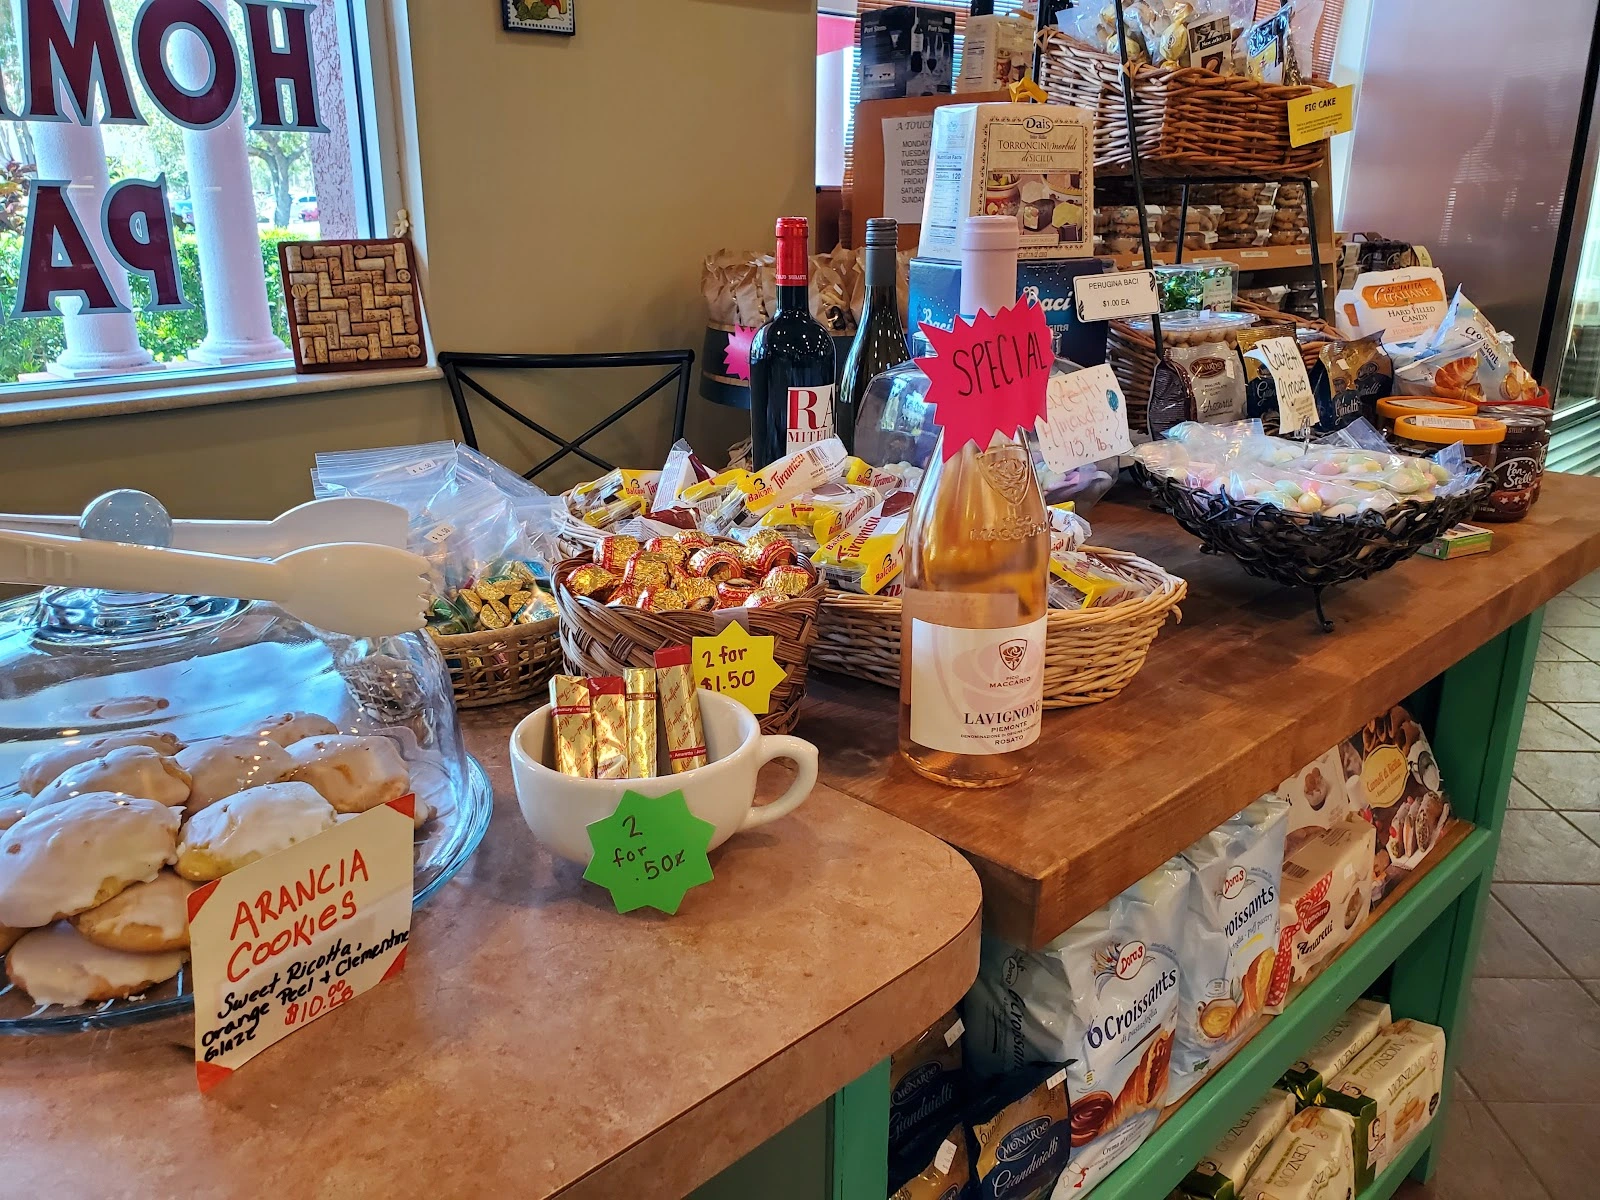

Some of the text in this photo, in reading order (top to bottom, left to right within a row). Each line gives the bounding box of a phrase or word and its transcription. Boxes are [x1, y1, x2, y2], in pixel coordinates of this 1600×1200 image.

[1304, 97, 1336, 112] FIG CAKE
[896, 122, 903, 130] A
[1026, 117, 1051, 129] Dais
[998, 140, 1049, 150] TORRONCINI
[1050, 136, 1077, 151] morbidi
[900, 159, 929, 167] WEDNES
[1029, 155, 1054, 163] SICILIA
[1088, 278, 1139, 290] PERUGINA BACI
[1102, 299, 1120, 308] $1.00
[1383, 288, 1433, 303] ITALIANE
[1387, 305, 1436, 318] HARD FILLED
[1401, 313, 1429, 323] CANDY
[953, 331, 1048, 397] SPECIAL
[787, 428, 834, 442] MITELL
[747, 484, 774, 503] Balconi
[826, 531, 851, 551] Balconi
[875, 561, 898, 582] Balconi
[702, 645, 748, 669] 2 for
[700, 668, 756, 692] $1.50
[990, 676, 1031, 688] MACCARIO
[964, 699, 1041, 725] LAVIGNONE
[991, 721, 1028, 733] PIEMONTE
[994, 734, 1025, 746] ROSATO
[622, 814, 643, 838] 2
[612, 845, 648, 868] for
[229, 848, 369, 941] ARANCIA
[1224, 885, 1275, 939] roissants
[1296, 919, 1333, 960] Amaretti
[276, 978, 314, 1006] Peel
[335, 928, 410, 977] Clementine
[217, 973, 281, 1019] Sweet
[1087, 968, 1177, 1049] 6 Croissants
[897, 1065, 938, 1100] MONARDO
[1387, 1055, 1426, 1097] VICENZOVO
[1000, 1121, 1049, 1159] MONARDO
[992, 1136, 1059, 1199] Gianduiotti
